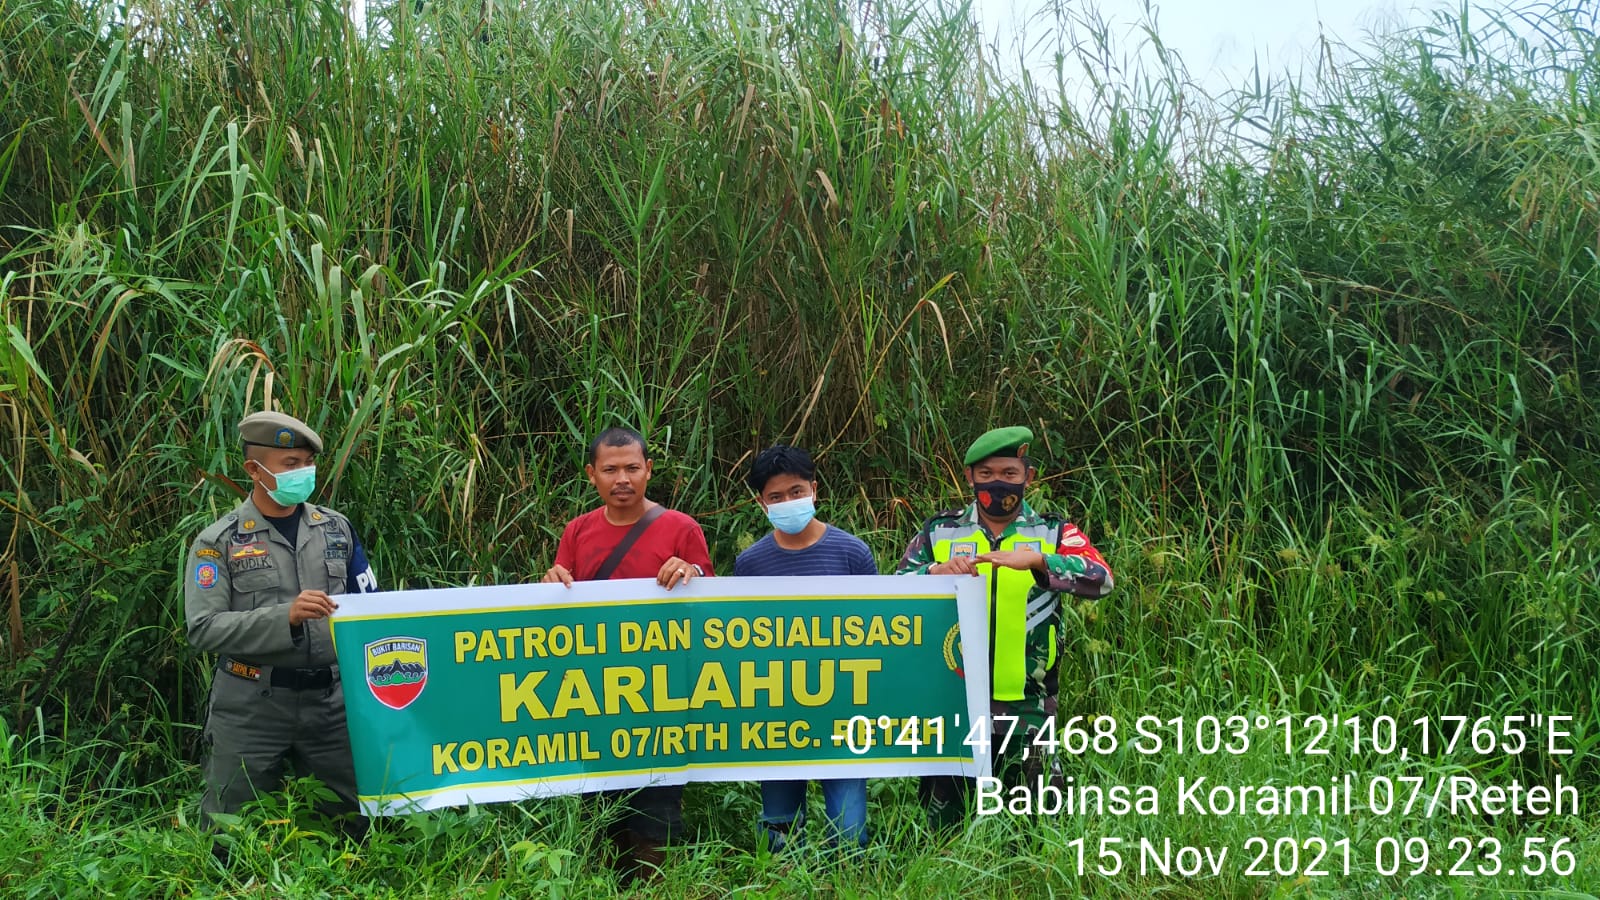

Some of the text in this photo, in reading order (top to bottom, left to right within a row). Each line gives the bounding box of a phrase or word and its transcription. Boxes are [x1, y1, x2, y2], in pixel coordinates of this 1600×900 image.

[371, 641, 421, 656] BUKIT BARISAN
[454, 615, 923, 664] PATROLI DAN SOSIALISASI
[499, 659, 882, 722] KARLAHUT
[432, 731, 600, 775] KORAMIL
[611, 722, 728, 758] 07/RTH
[741, 721, 822, 750] KEC.
